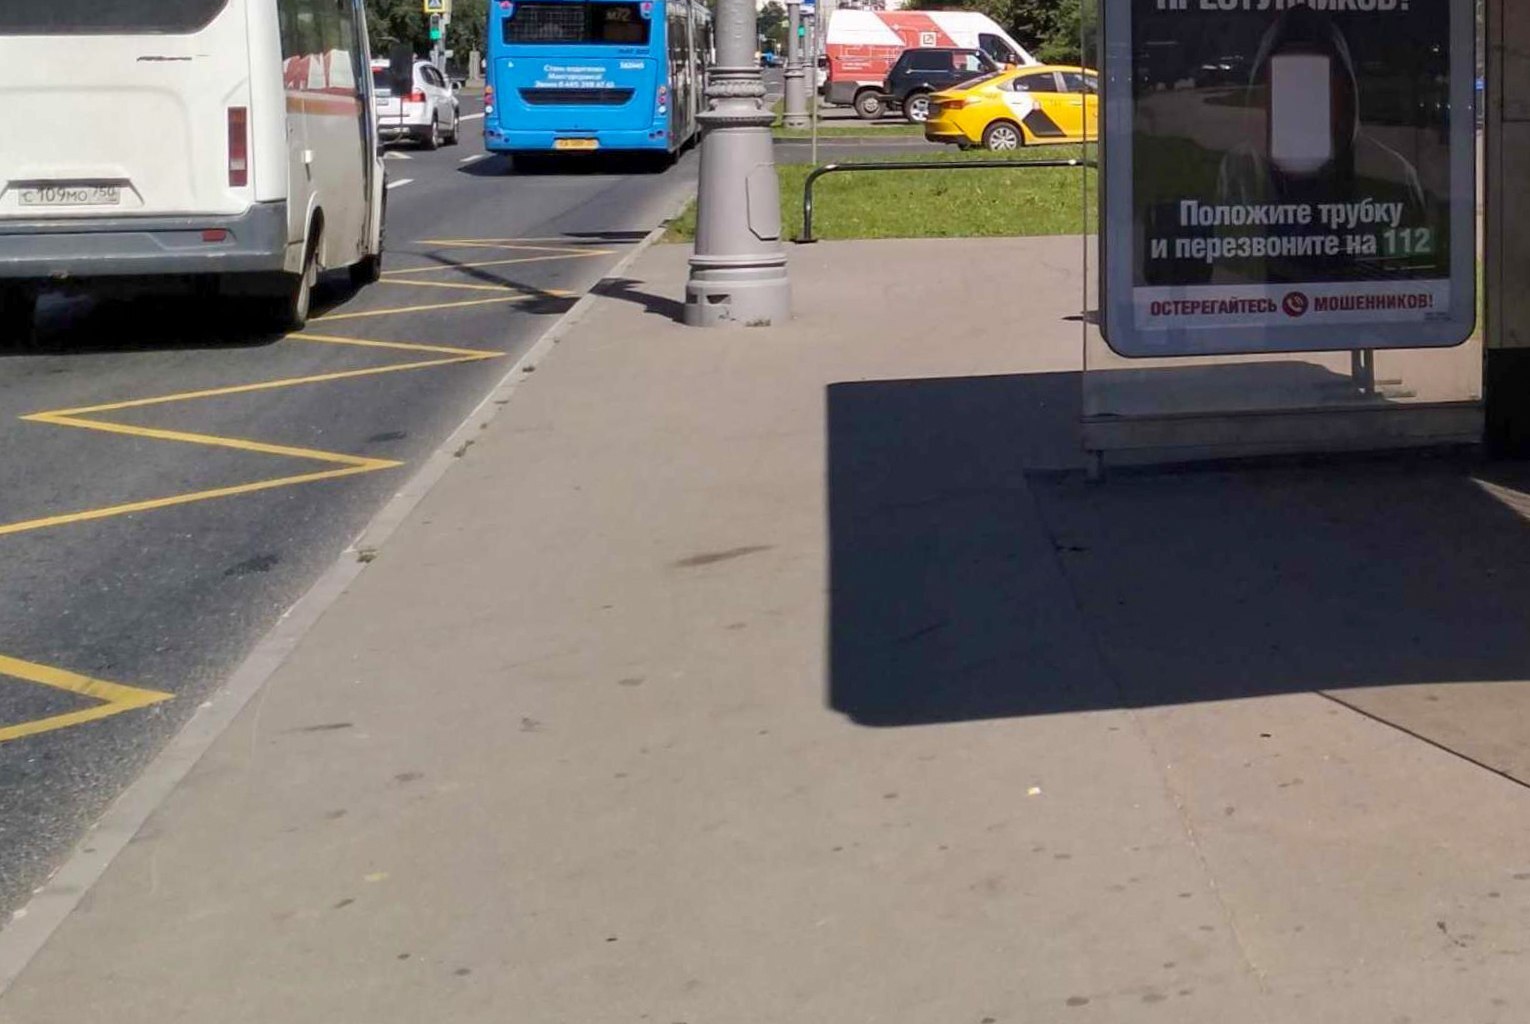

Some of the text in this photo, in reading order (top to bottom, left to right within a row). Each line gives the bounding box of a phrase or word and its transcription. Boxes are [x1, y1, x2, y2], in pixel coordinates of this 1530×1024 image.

[1180, 197, 1405, 230] Положите трубку
[1150, 228, 1432, 264] и перезвоните на 112
[1150, 292, 1434, 317] ОСТЕРЕГАЙТЕСЬ МОШЕННИКОВ!
